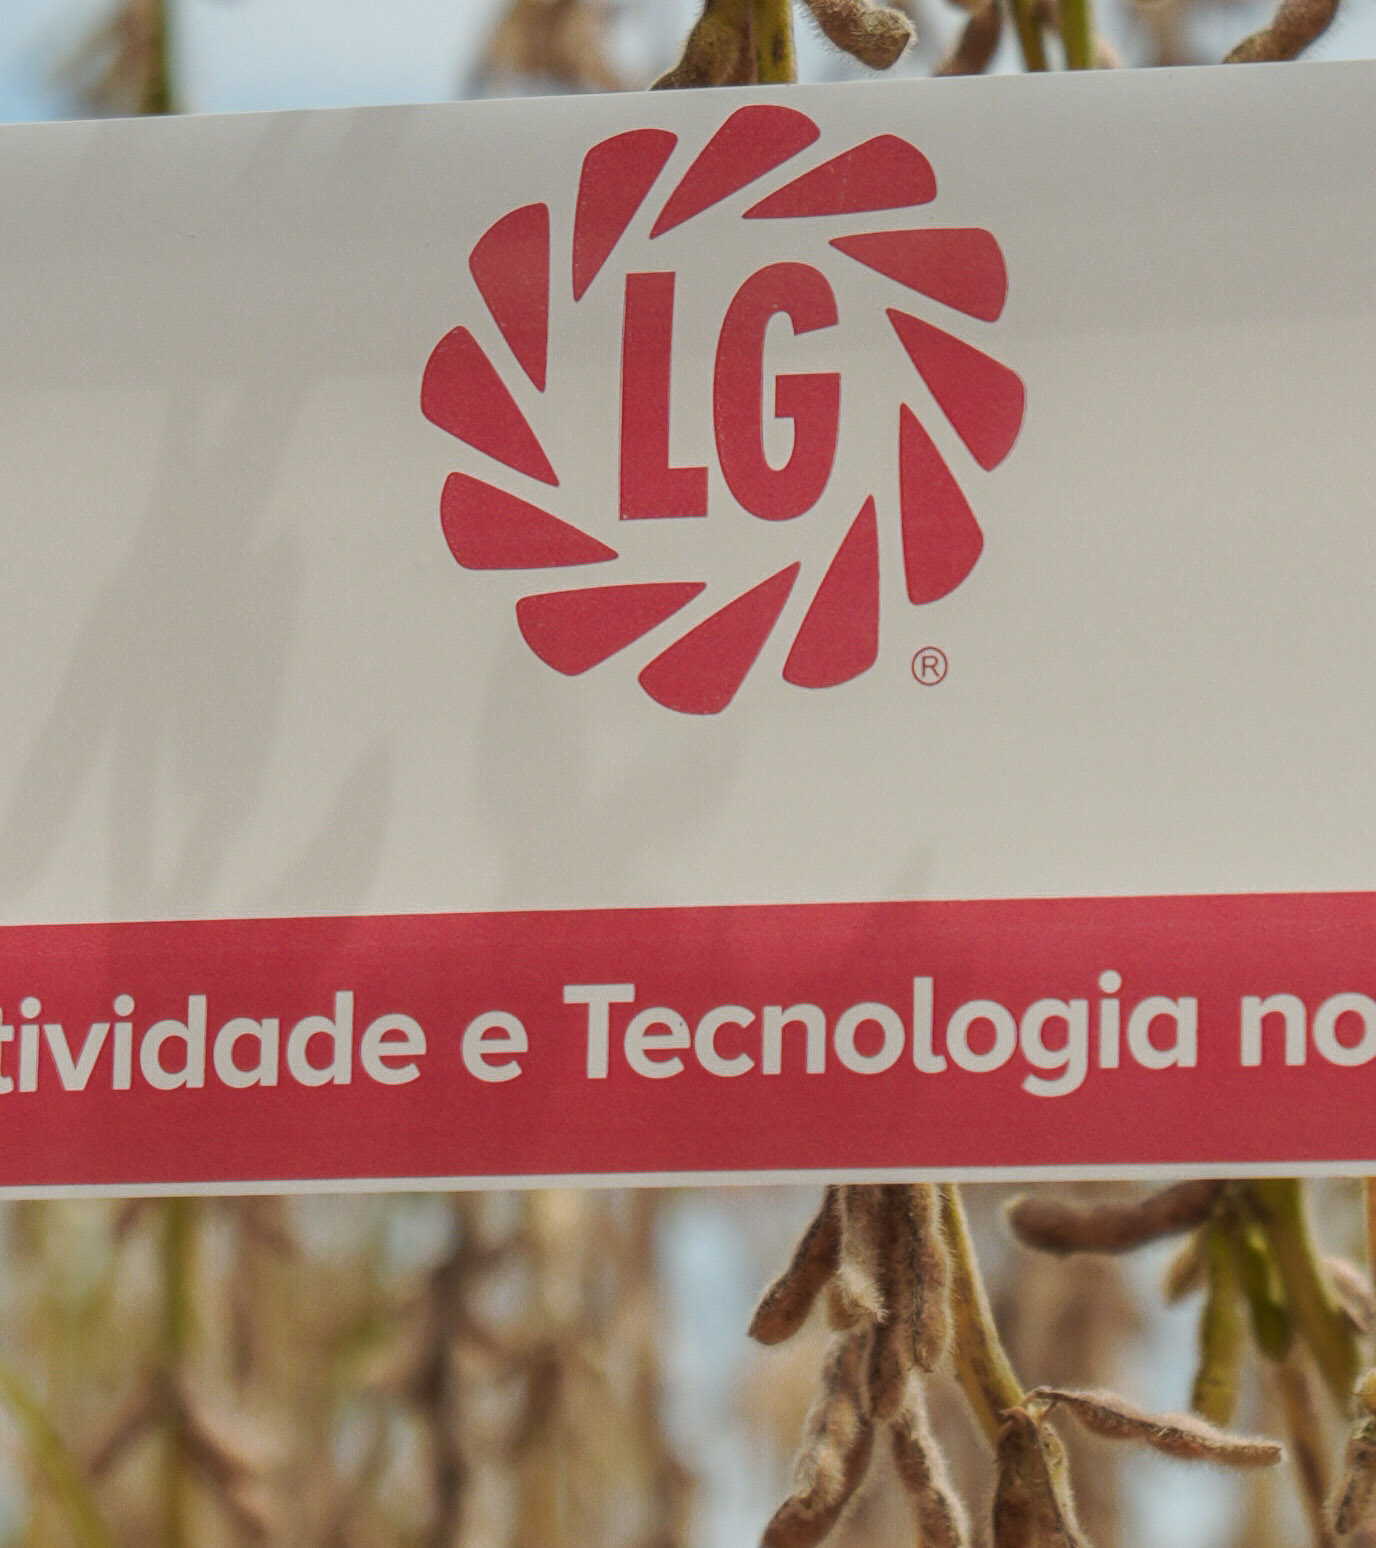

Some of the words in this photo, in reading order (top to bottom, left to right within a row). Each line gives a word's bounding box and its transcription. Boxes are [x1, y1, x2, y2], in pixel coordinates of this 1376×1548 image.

[619, 261, 841, 522] LG
[460, 1009, 529, 1083] e
[562, 969, 1199, 1097] Tecnologia
